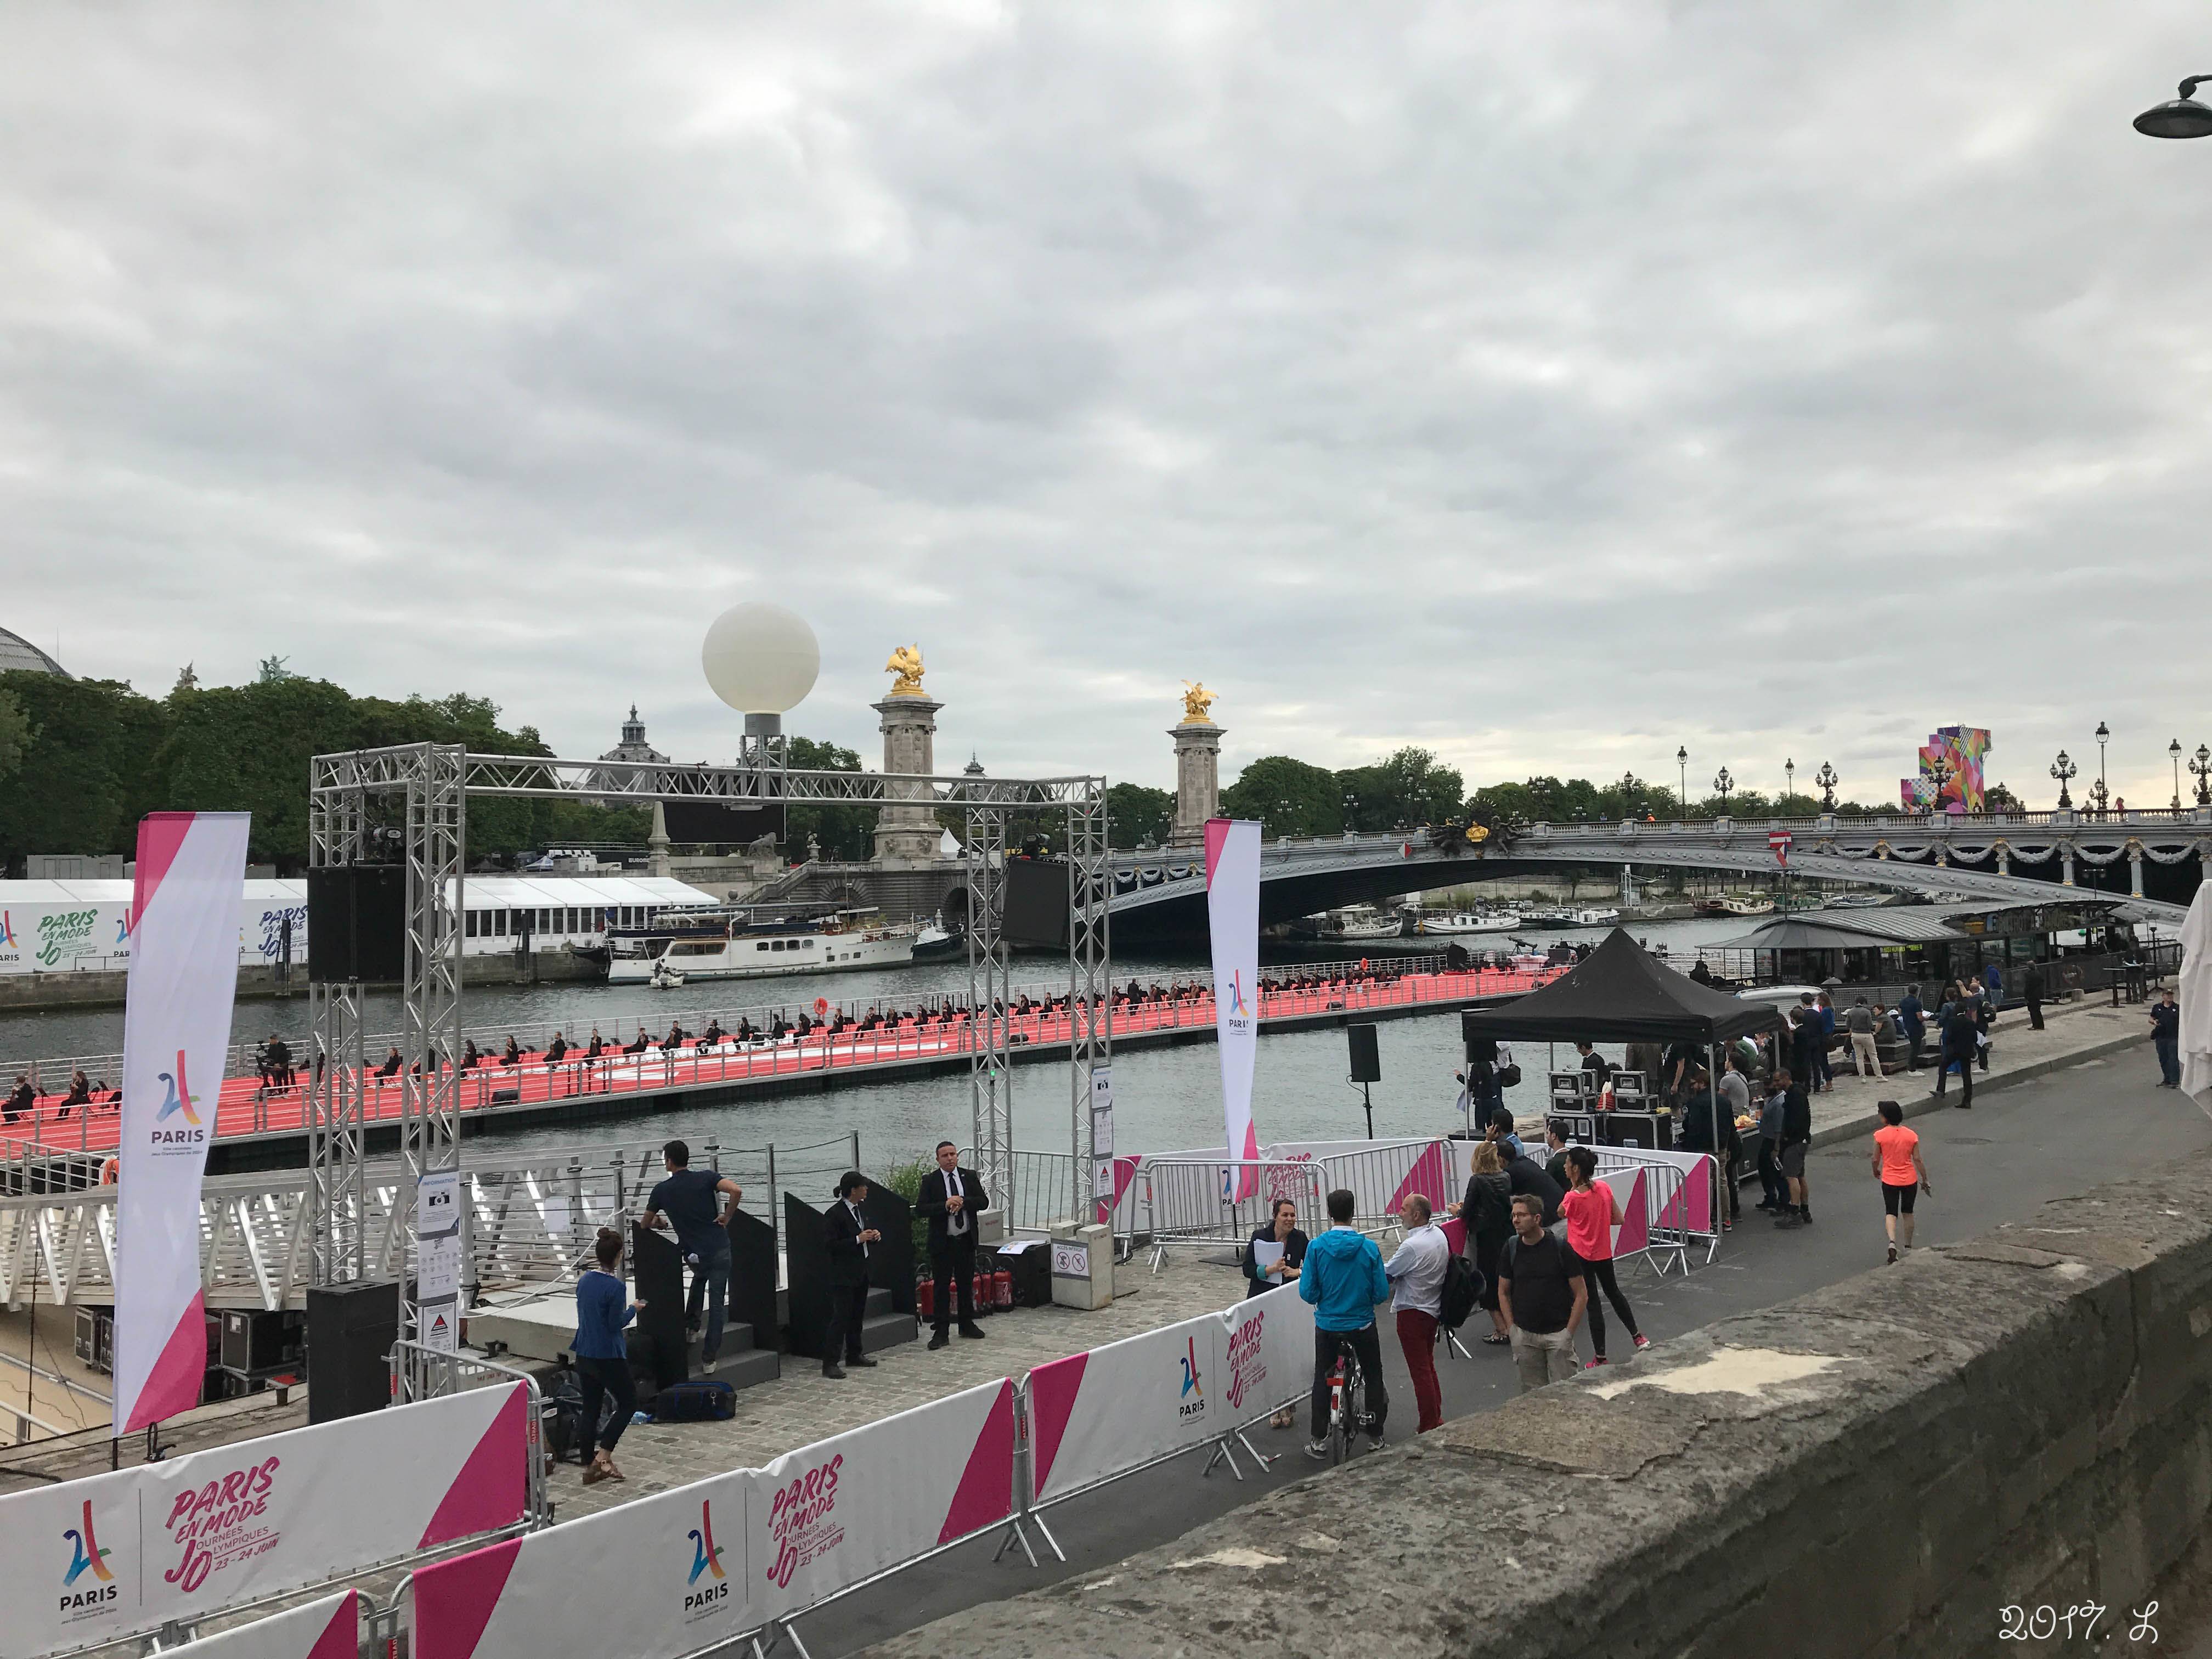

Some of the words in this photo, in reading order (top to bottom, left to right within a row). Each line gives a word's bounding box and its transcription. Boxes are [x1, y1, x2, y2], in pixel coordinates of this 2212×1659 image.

[37, 909, 98, 933] PARIS
[258, 905, 308, 927] PARIS
[41, 931, 57, 941] EN
[55, 926, 94, 940] MODE
[151, 1130, 204, 1144] PARIS
[1227, 1310, 1264, 1361] PARIS
[1180, 1399, 1204, 1418] PARIS
[165, 1456, 280, 1529] PARIS
[768, 1454, 843, 1528] PARIS
[175, 1517, 203, 1544] EN
[200, 1492, 272, 1537] MODE
[773, 1514, 791, 1542] EN
[788, 1488, 838, 1534] MODE
[196, 1526, 242, 1550] OURNÉES
[213, 1526, 269, 1555] LYMPIQUES
[798, 1522, 837, 1550] LYMPIQUES
[215, 1558, 228, 1571] 23
[238, 1548, 253, 1561] 24
[254, 1537, 280, 1556] JUIN
[800, 1554, 812, 1567] 23
[817, 1543, 827, 1557] 24
[60, 1585, 117, 1611] PARIS
[685, 1582, 728, 1611] PARIS
